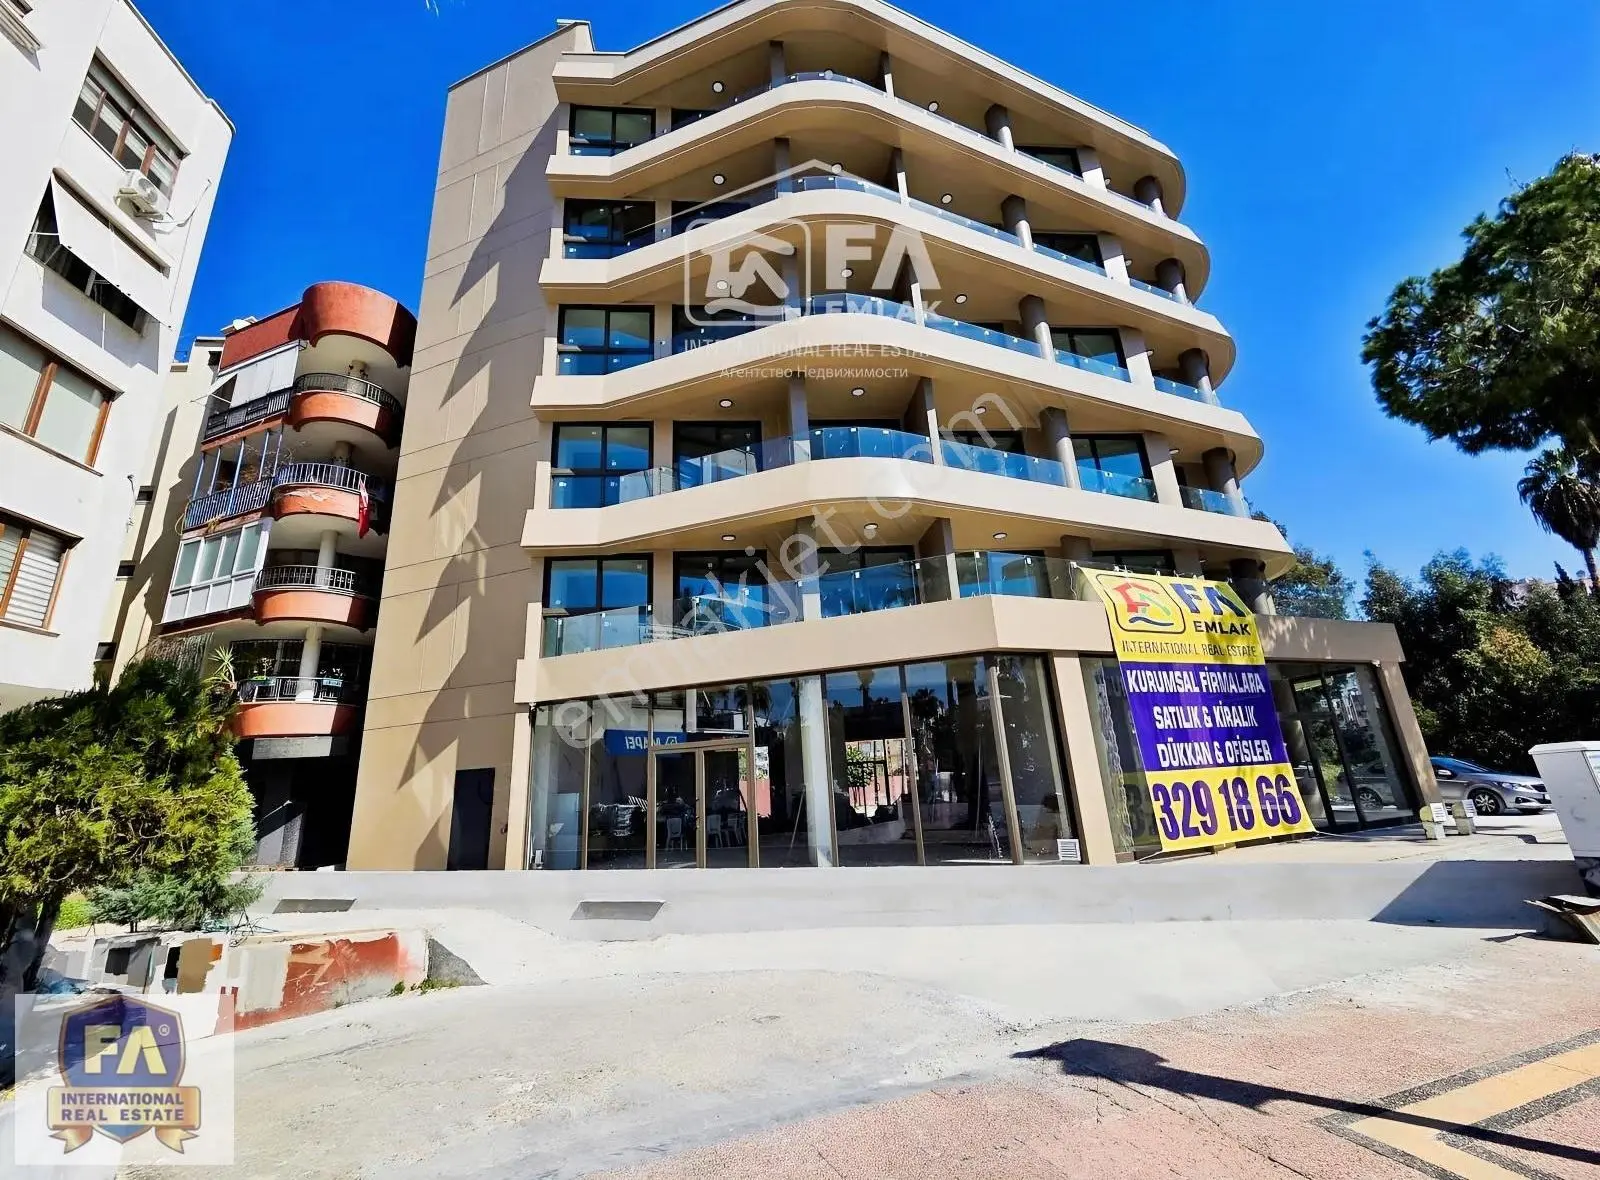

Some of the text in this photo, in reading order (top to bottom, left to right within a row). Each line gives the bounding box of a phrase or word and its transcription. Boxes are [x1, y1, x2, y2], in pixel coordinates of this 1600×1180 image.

[1169, 583, 1247, 617] FA
[1193, 620, 1251, 636] EMLAK
[1121, 640, 1257, 657] INTERNATIONAL REAL ESTATE
[1126, 668, 1199, 693] KURUMSAL
[1200, 666, 1266, 693] FİRMALARA
[1153, 700, 1259, 730] SATILIK & KİRALIK
[1156, 735, 1273, 768] DÜKKAN & OFİSLER
[1152, 779, 1219, 841] 329
[1218, 776, 1256, 832] 18
[1255, 773, 1303, 828] 66
